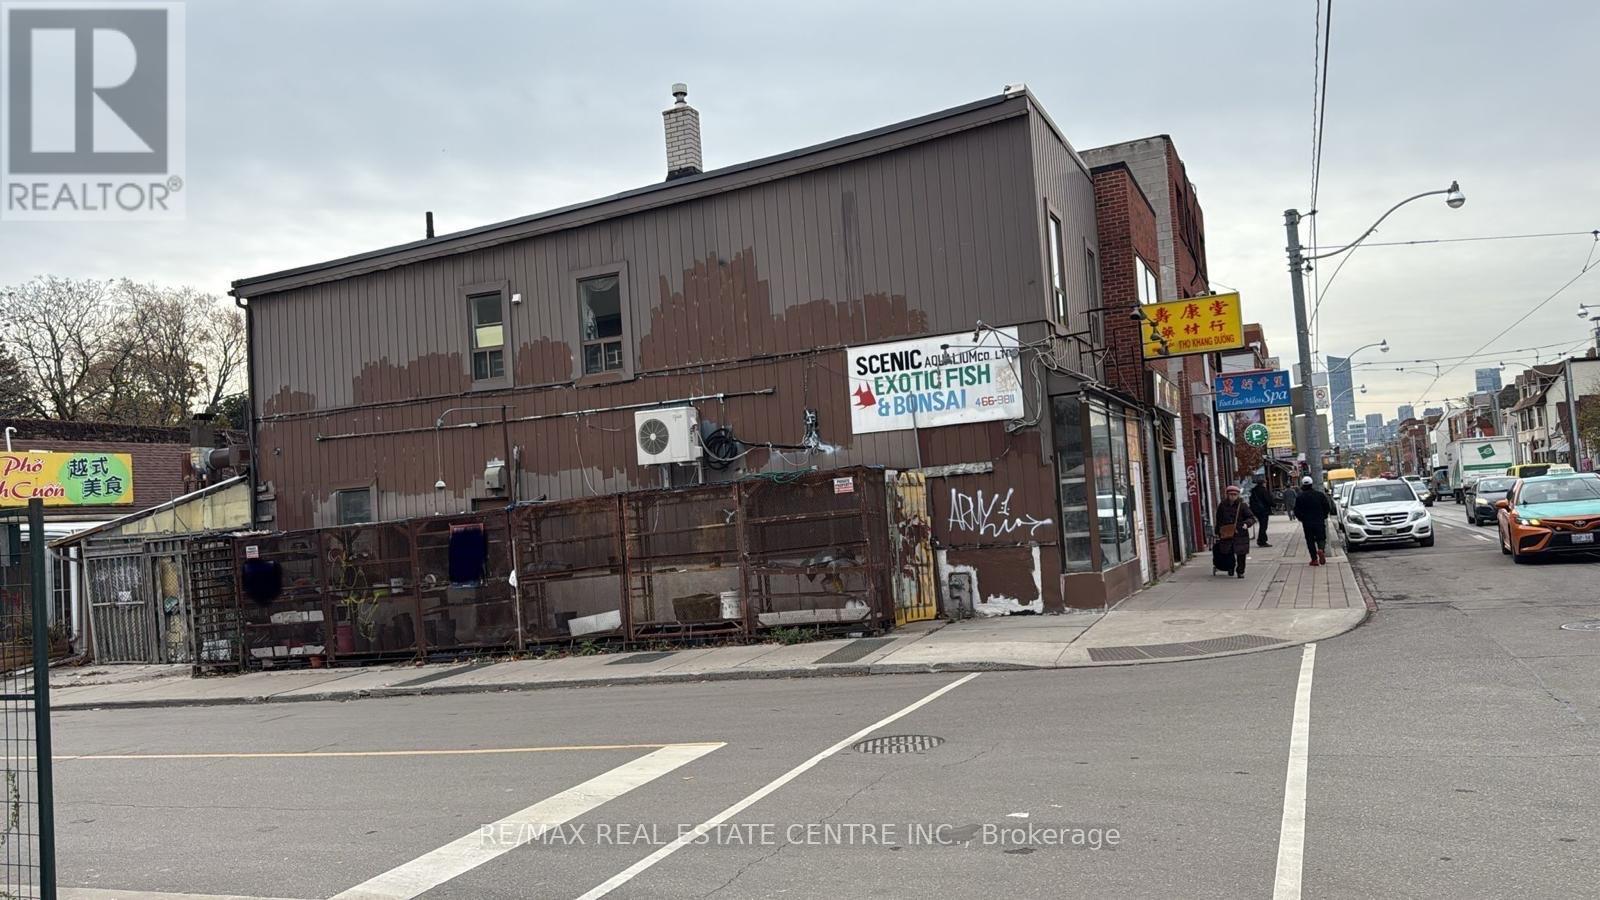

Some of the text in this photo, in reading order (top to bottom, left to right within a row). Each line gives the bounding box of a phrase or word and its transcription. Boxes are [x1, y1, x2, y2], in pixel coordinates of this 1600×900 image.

[856, 349, 922, 376] SCENIC
[874, 363, 991, 396] EXOTIC FISH
[878, 388, 967, 417] & BONSAI
[1263, 389, 1288, 405] Spa
[1252, 429, 1262, 441] P
[68, 457, 109, 478] 越式
[83, 476, 122, 497] 美食
